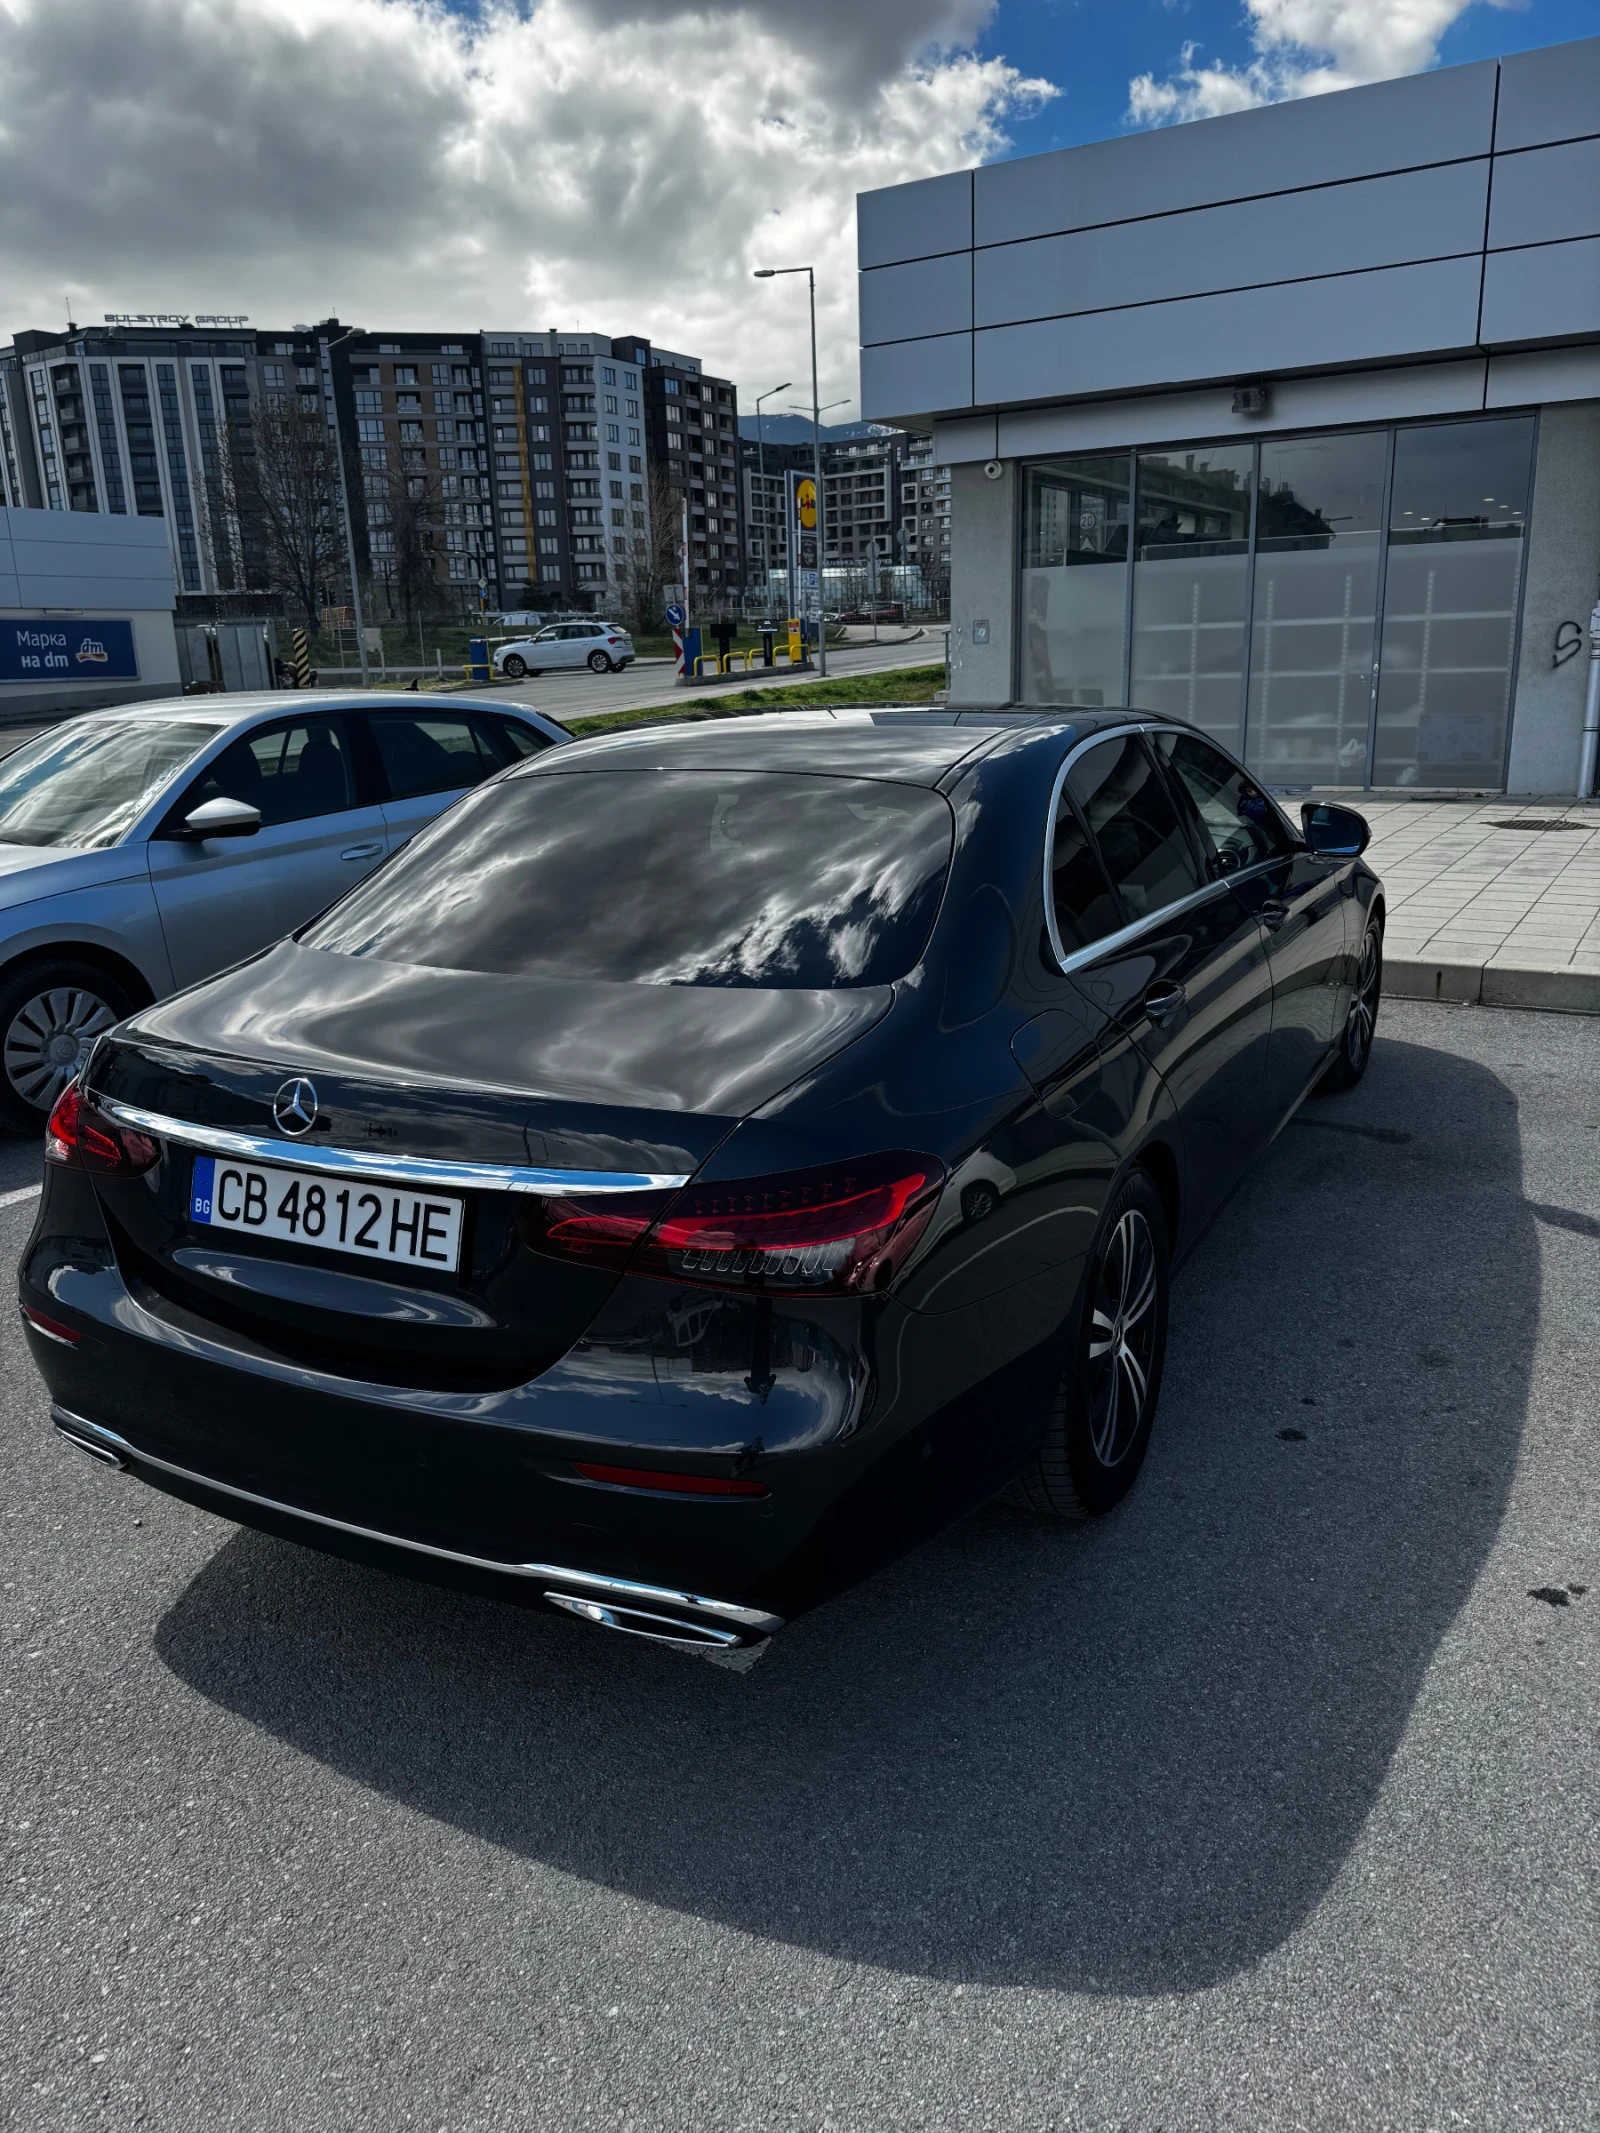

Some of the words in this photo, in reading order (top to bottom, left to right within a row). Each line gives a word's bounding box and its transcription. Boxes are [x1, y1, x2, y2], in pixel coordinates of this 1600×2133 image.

[104, 314, 190, 323] BULSTROY
[195, 315, 249, 324] GROUP
[1081, 515, 1093, 527] 20
[16, 630, 67, 649] Марка
[80, 638, 104, 654] dm
[21, 654, 40, 668] на
[44, 651, 69, 668] dm
[195, 1198, 210, 1215] BG
